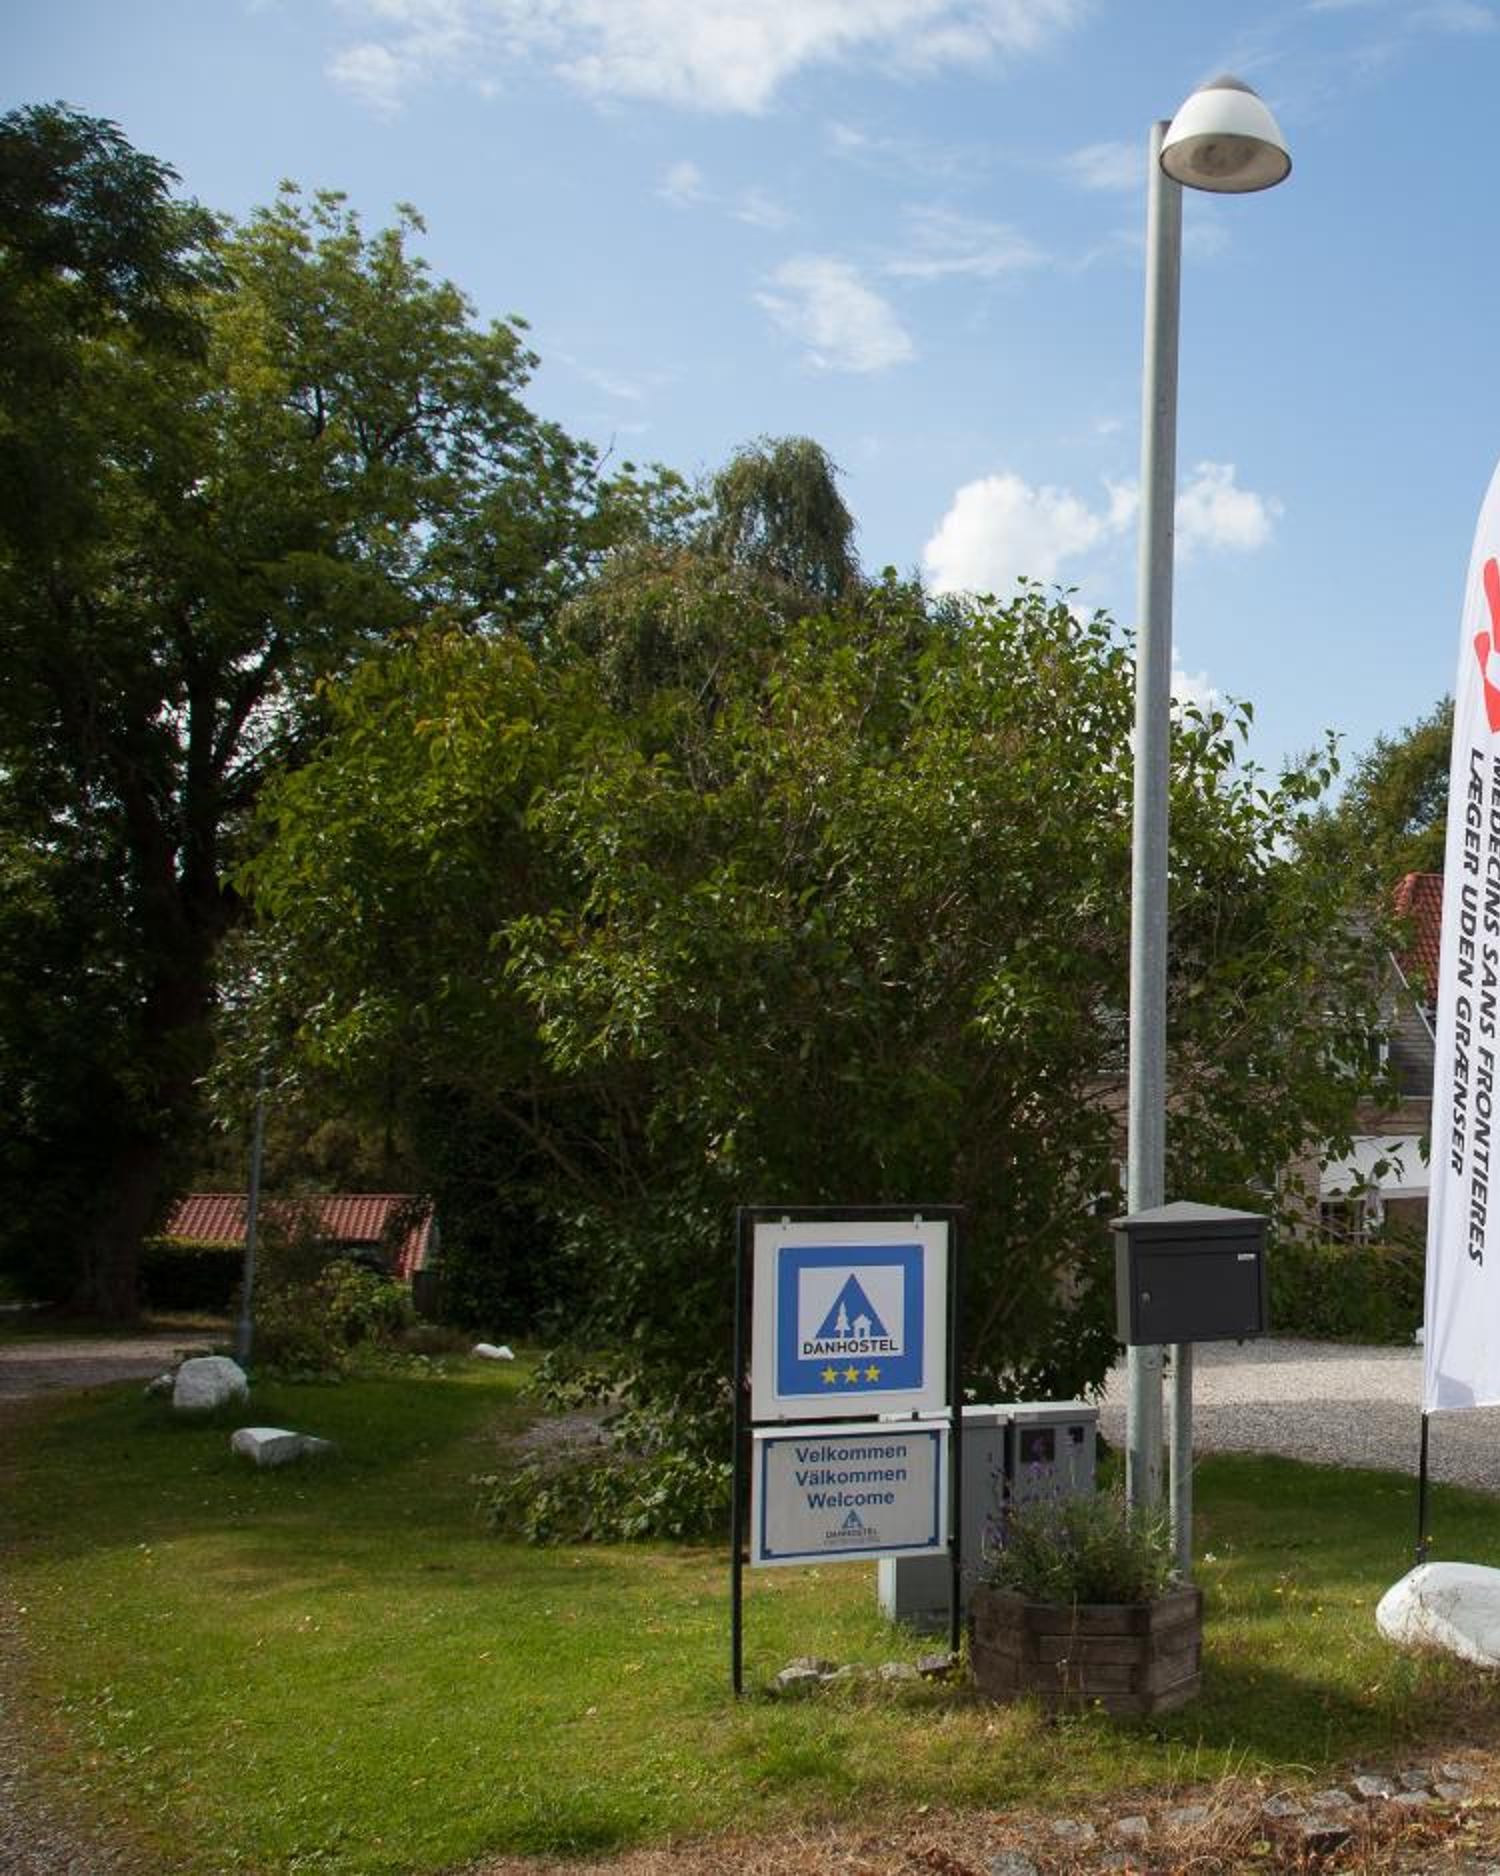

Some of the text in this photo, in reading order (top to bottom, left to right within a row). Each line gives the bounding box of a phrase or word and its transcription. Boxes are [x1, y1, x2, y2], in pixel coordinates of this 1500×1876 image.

[1451, 748, 1484, 1176] LÆGER UDEN GRÆNSER
[1479, 943, 1499, 1039] SANS
[1468, 1046, 1495, 1267] FRONTIERES
[802, 1338, 899, 1355] DANHOSTEL
[795, 1445, 907, 1463] Velkommen
[795, 1467, 907, 1487] Välkommen
[807, 1490, 895, 1509] Welcome
